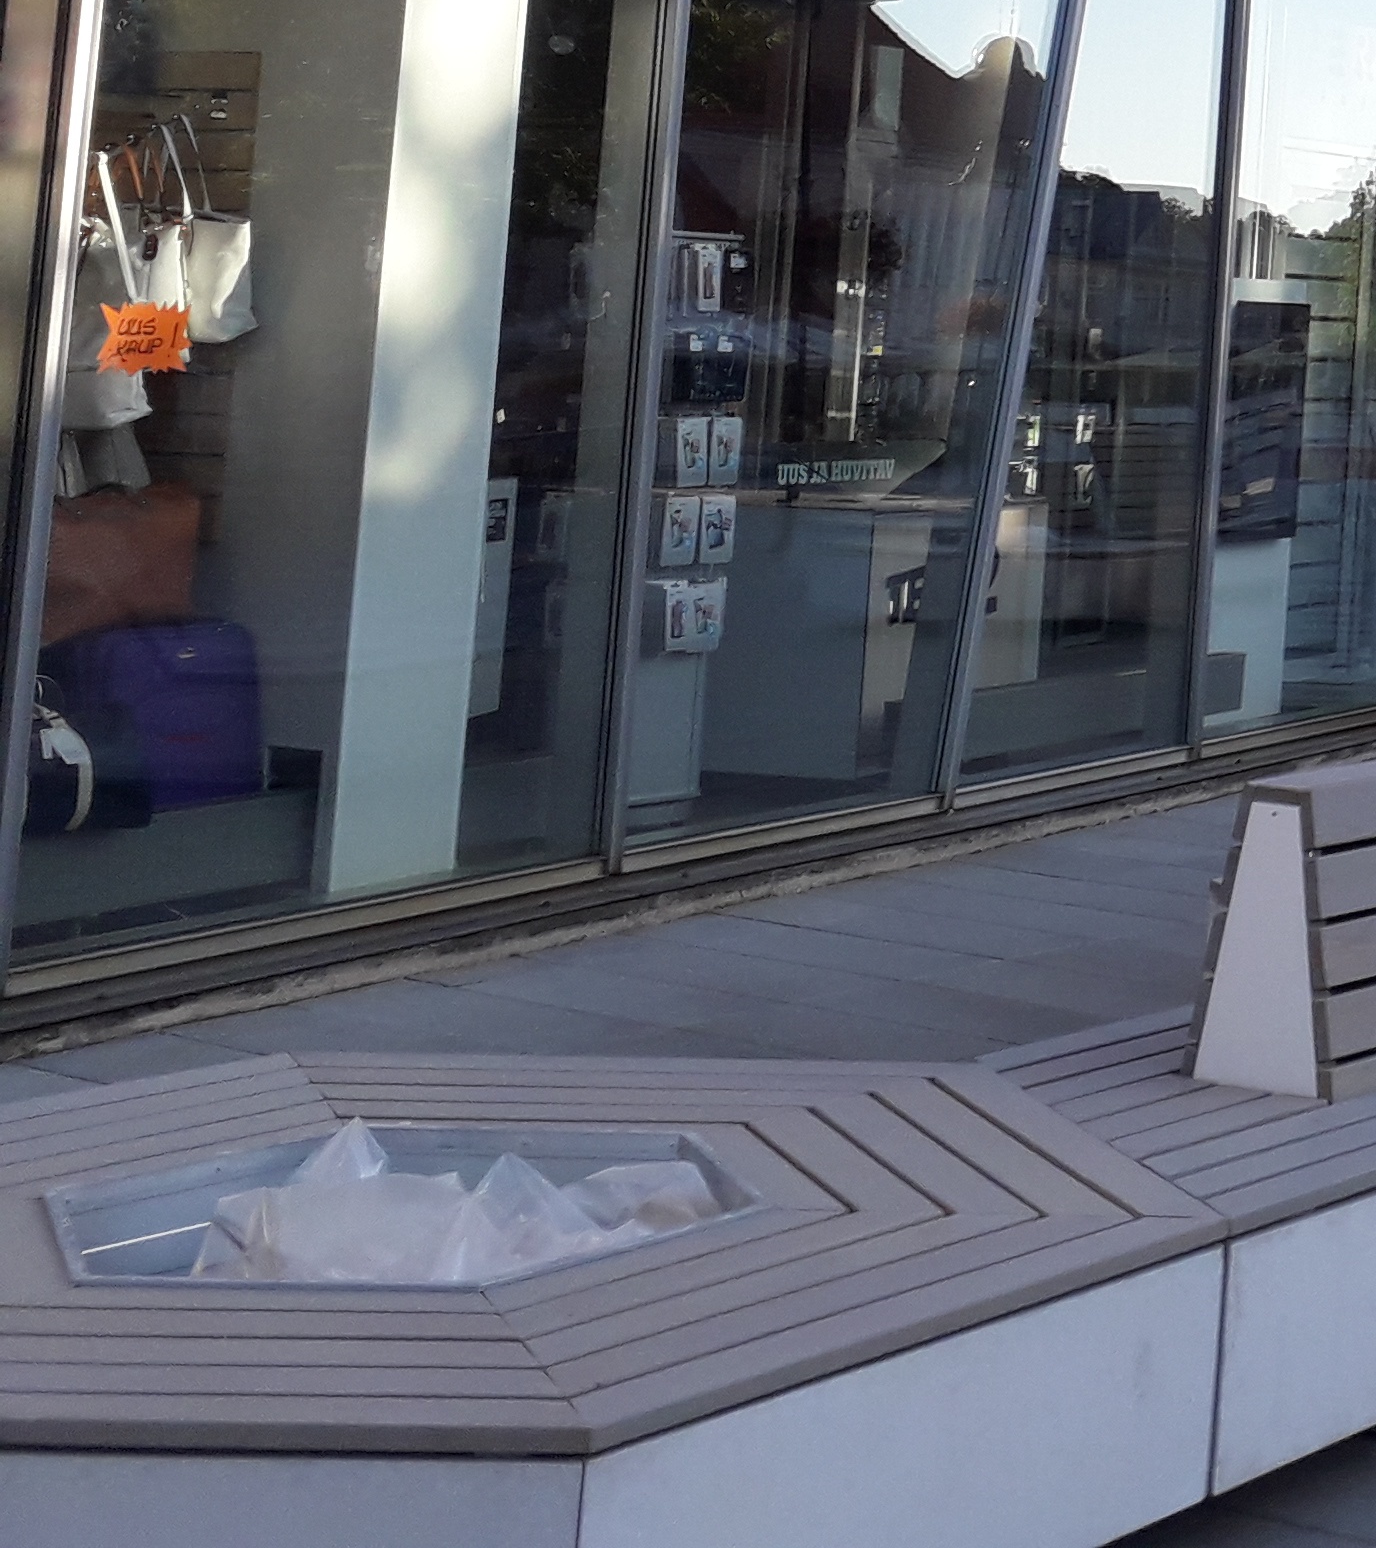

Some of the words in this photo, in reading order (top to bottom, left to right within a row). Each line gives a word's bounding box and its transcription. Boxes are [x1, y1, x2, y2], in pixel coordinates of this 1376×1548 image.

[118, 316, 157, 336] UUS
[777, 462, 809, 485] UUS
[830, 458, 895, 482] HUVITAV
